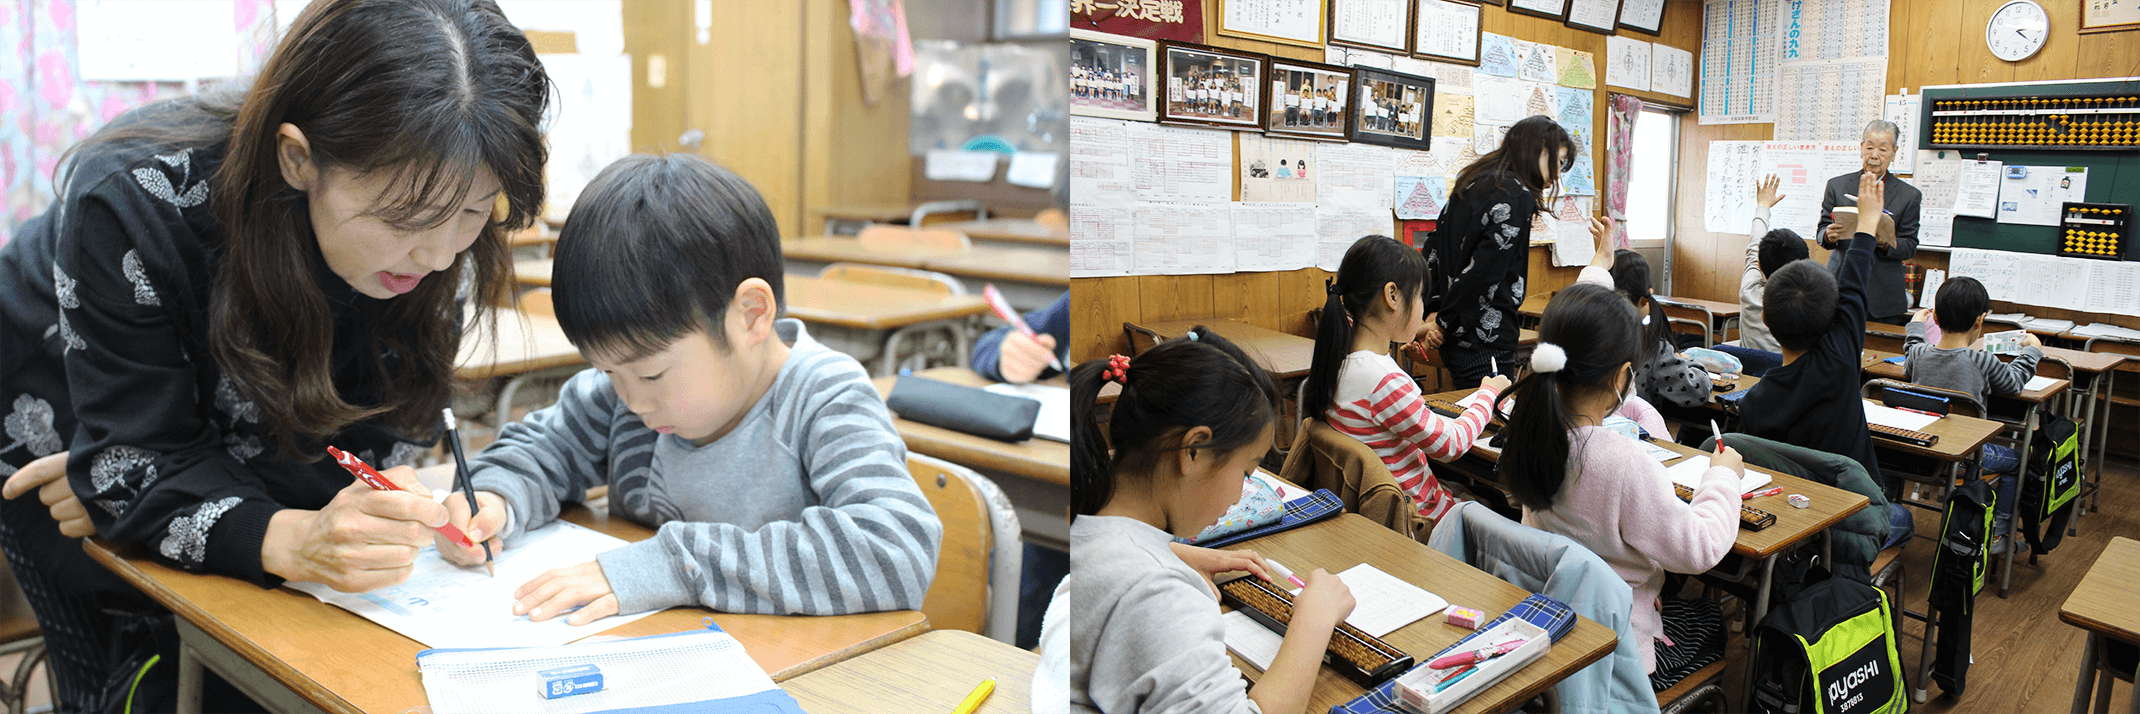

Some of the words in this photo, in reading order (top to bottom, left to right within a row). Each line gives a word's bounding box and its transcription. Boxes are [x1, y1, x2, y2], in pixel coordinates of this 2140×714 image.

[2015, 5, 2022, 13] 12
[2028, 7, 2031, 15] 1
[1997, 17, 2003, 25] 10
[1994, 39, 2000, 47] 8
[2003, 46, 2008, 54] 7
[2013, 48, 2018, 56] 6
[2024, 45, 2029, 53] 5
